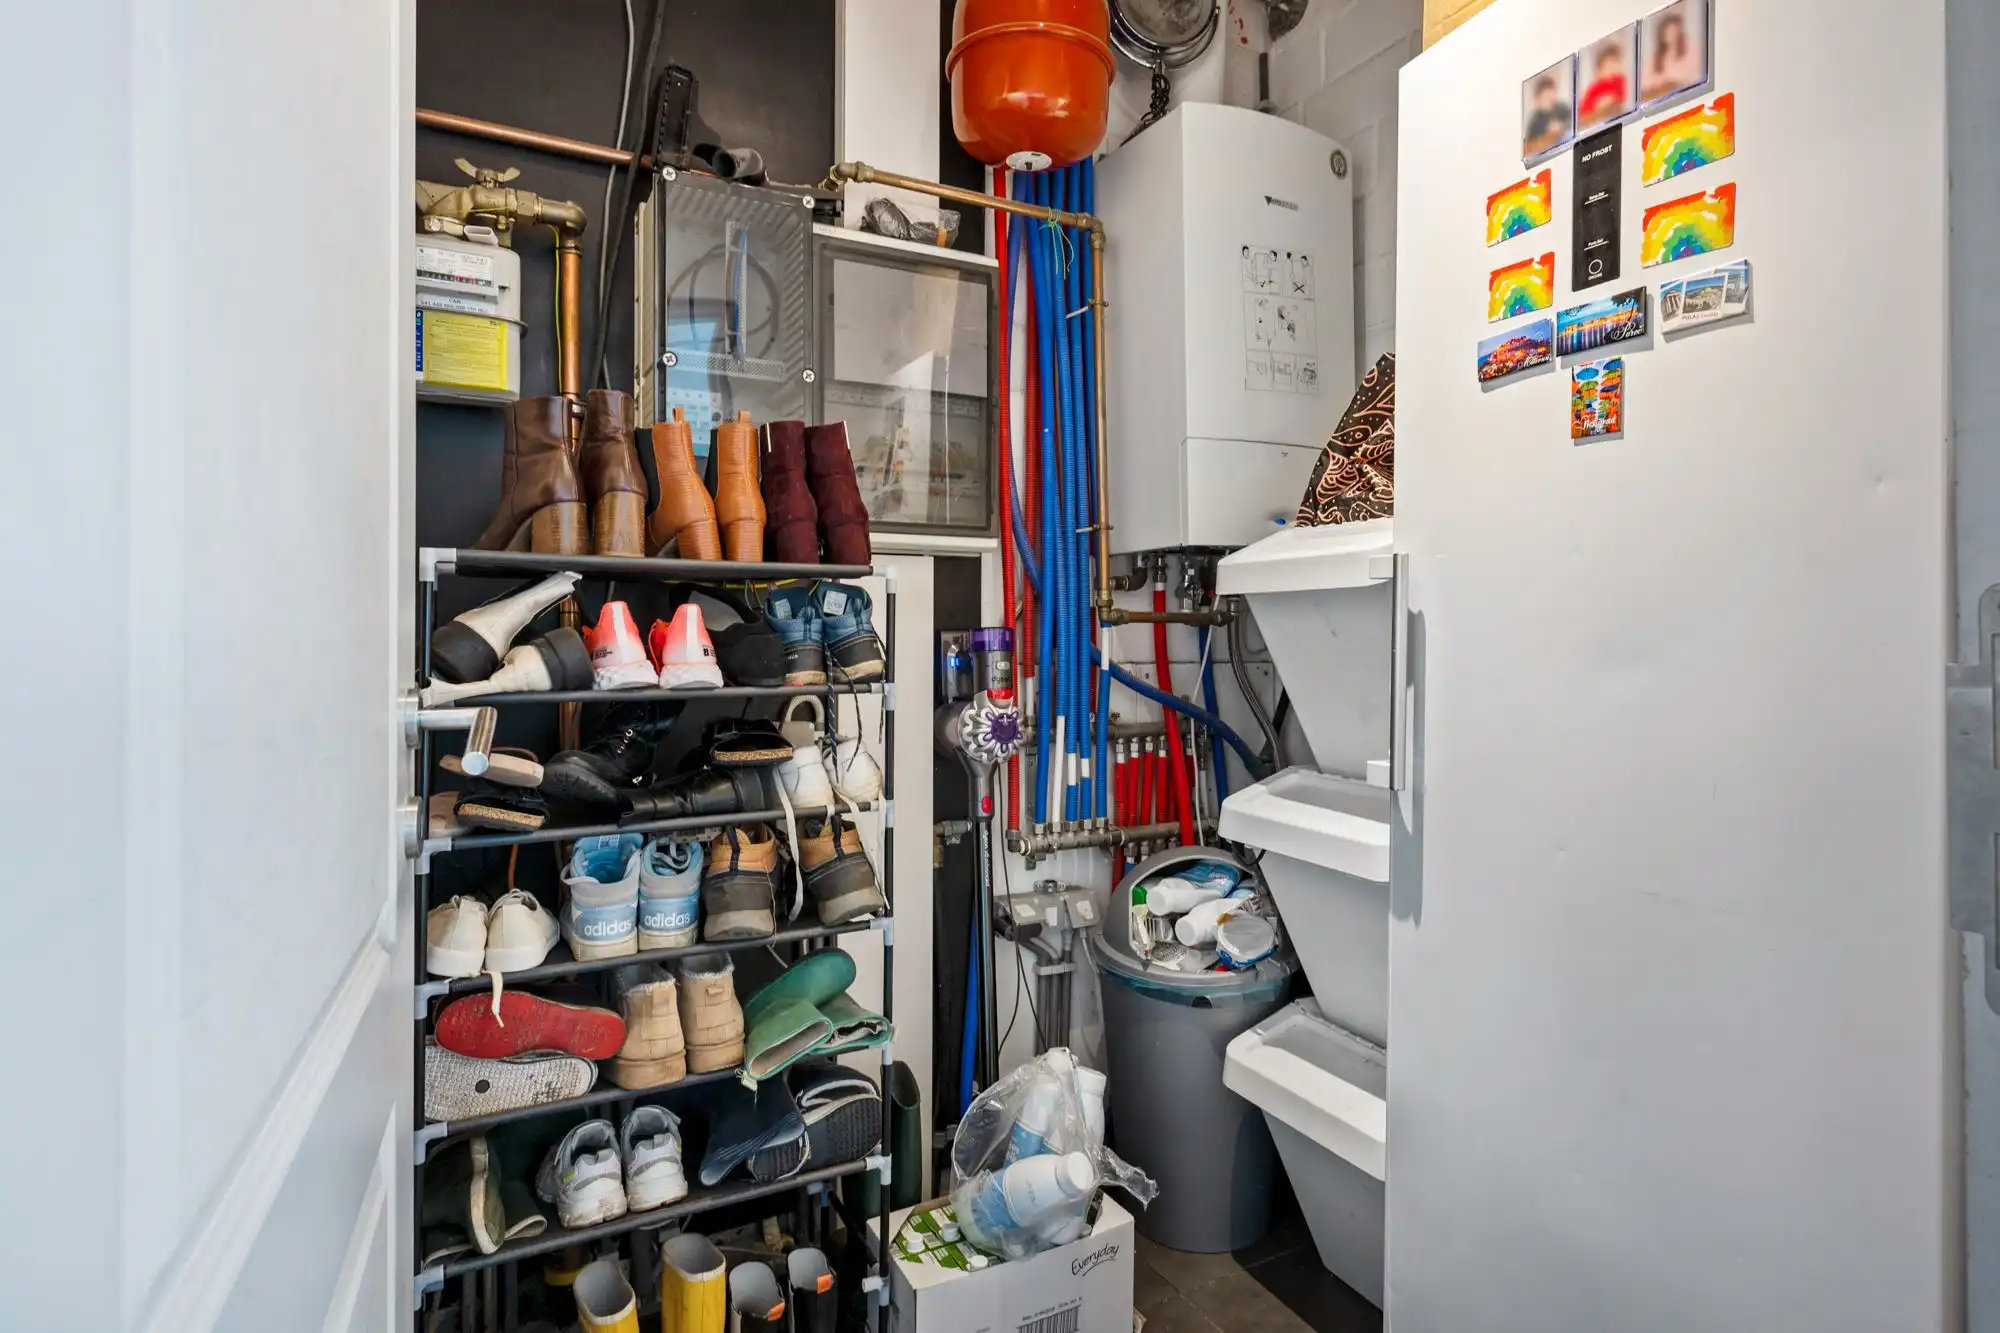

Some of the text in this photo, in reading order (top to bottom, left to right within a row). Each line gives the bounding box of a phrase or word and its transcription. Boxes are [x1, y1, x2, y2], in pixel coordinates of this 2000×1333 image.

[1581, 144, 1613, 163] NO FROST
[584, 919, 632, 937] adidas
[644, 911, 691, 928] adidas
[1071, 1243, 1120, 1276] Everyday
